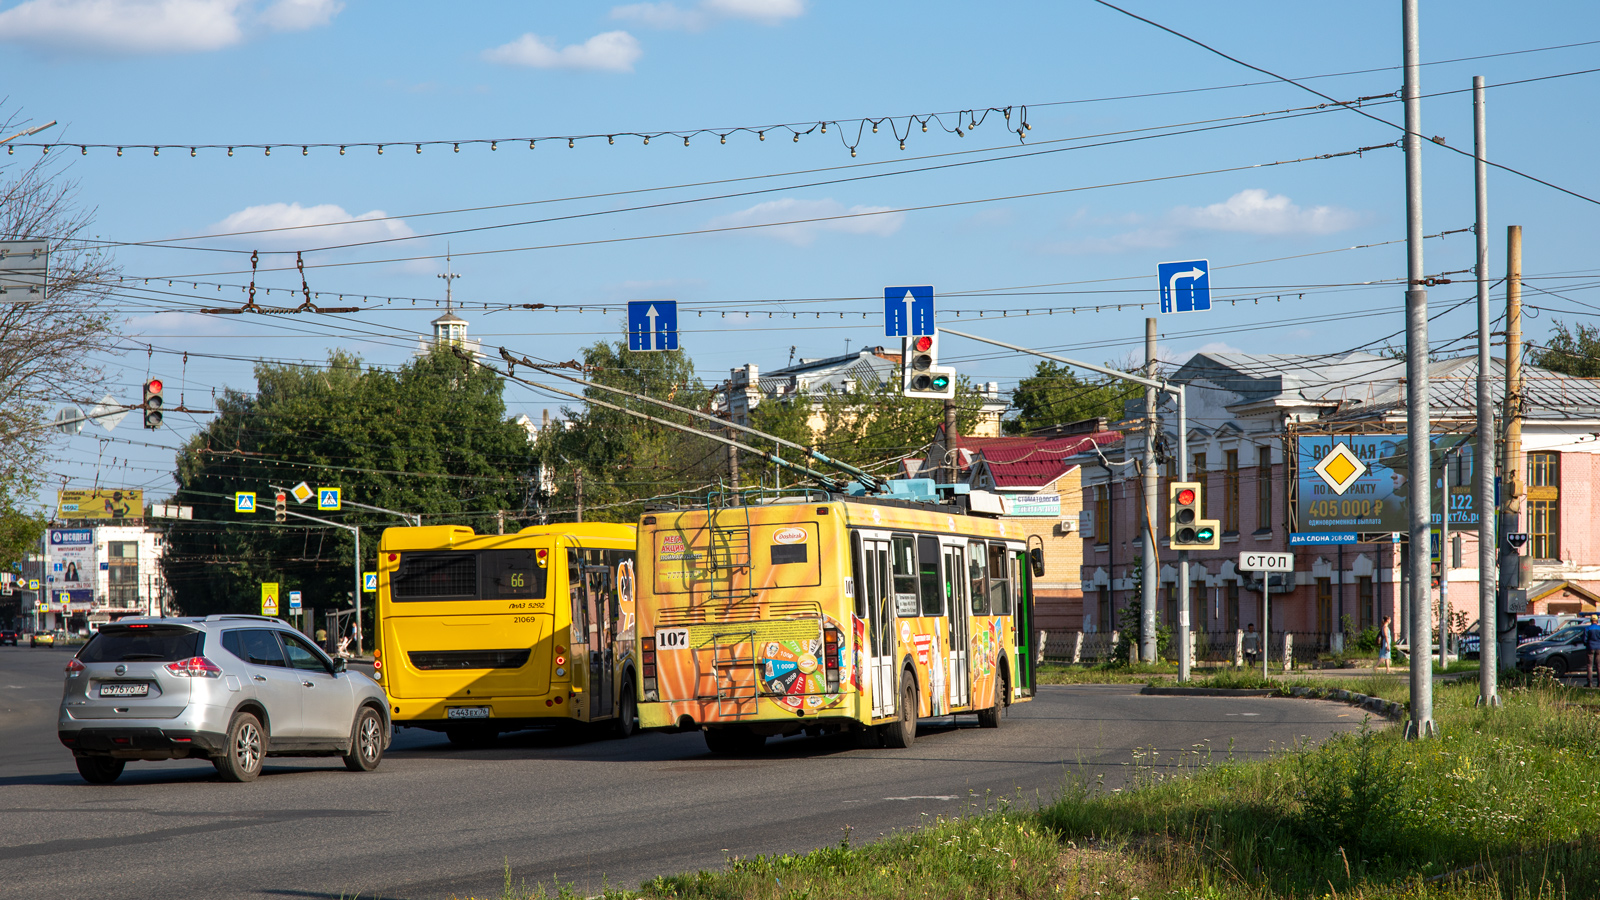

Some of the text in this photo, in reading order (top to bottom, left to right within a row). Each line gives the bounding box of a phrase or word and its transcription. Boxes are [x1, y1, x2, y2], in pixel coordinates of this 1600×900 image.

[1313, 444, 1376, 460] ВОНАЯ
[1314, 484, 1377, 495] ПО КРАКТУ
[1309, 500, 1339, 518] 405
[1341, 500, 1371, 517] 000
[1451, 494, 1473, 510] 122
[664, 535, 683, 545] МЕГА
[661, 544, 686, 555] АКЦИЯ
[1247, 555, 1287, 568] СТОП
[511, 572, 524, 587] 66
[659, 631, 687, 647] 107
